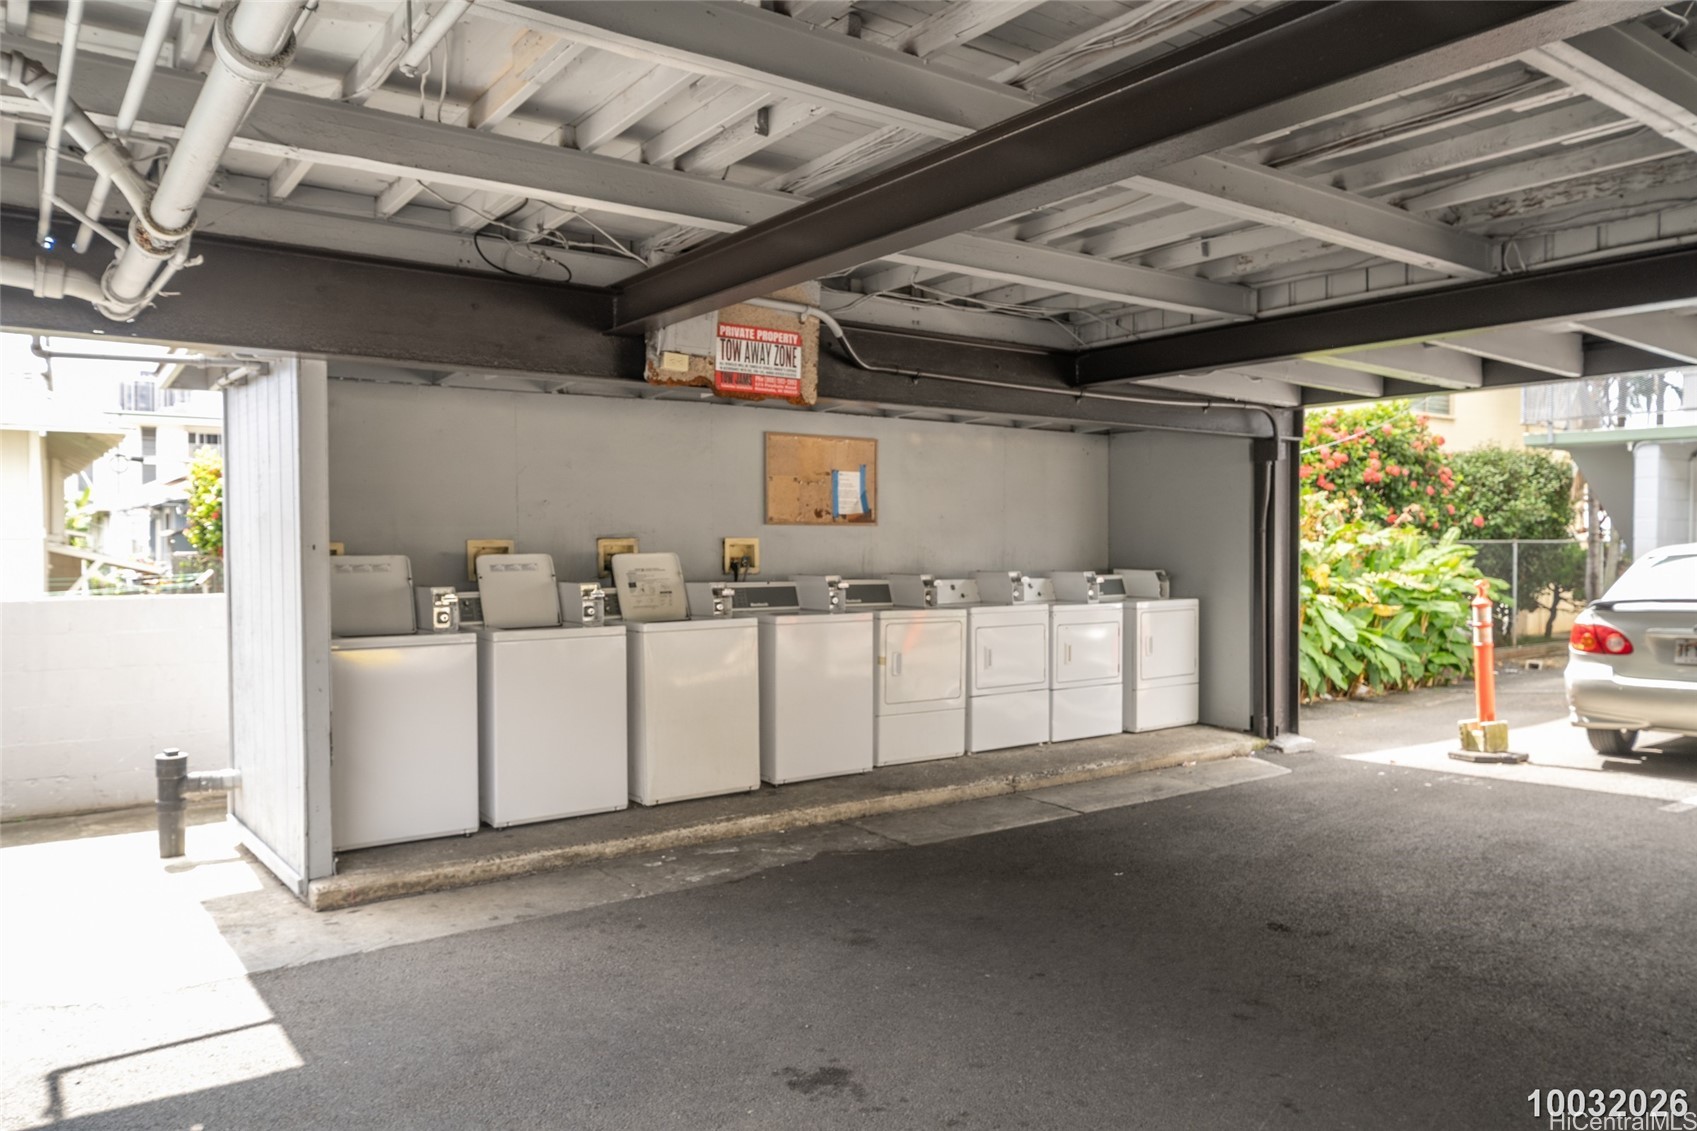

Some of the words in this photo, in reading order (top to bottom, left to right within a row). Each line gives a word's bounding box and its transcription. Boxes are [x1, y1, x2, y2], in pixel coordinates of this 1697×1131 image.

[719, 325, 755, 339] PRIVATE
[756, 329, 799, 344] PROPERTY
[720, 338, 742, 362] TOW
[744, 341, 772, 365] AWAY
[773, 344, 798, 368] ZONE
